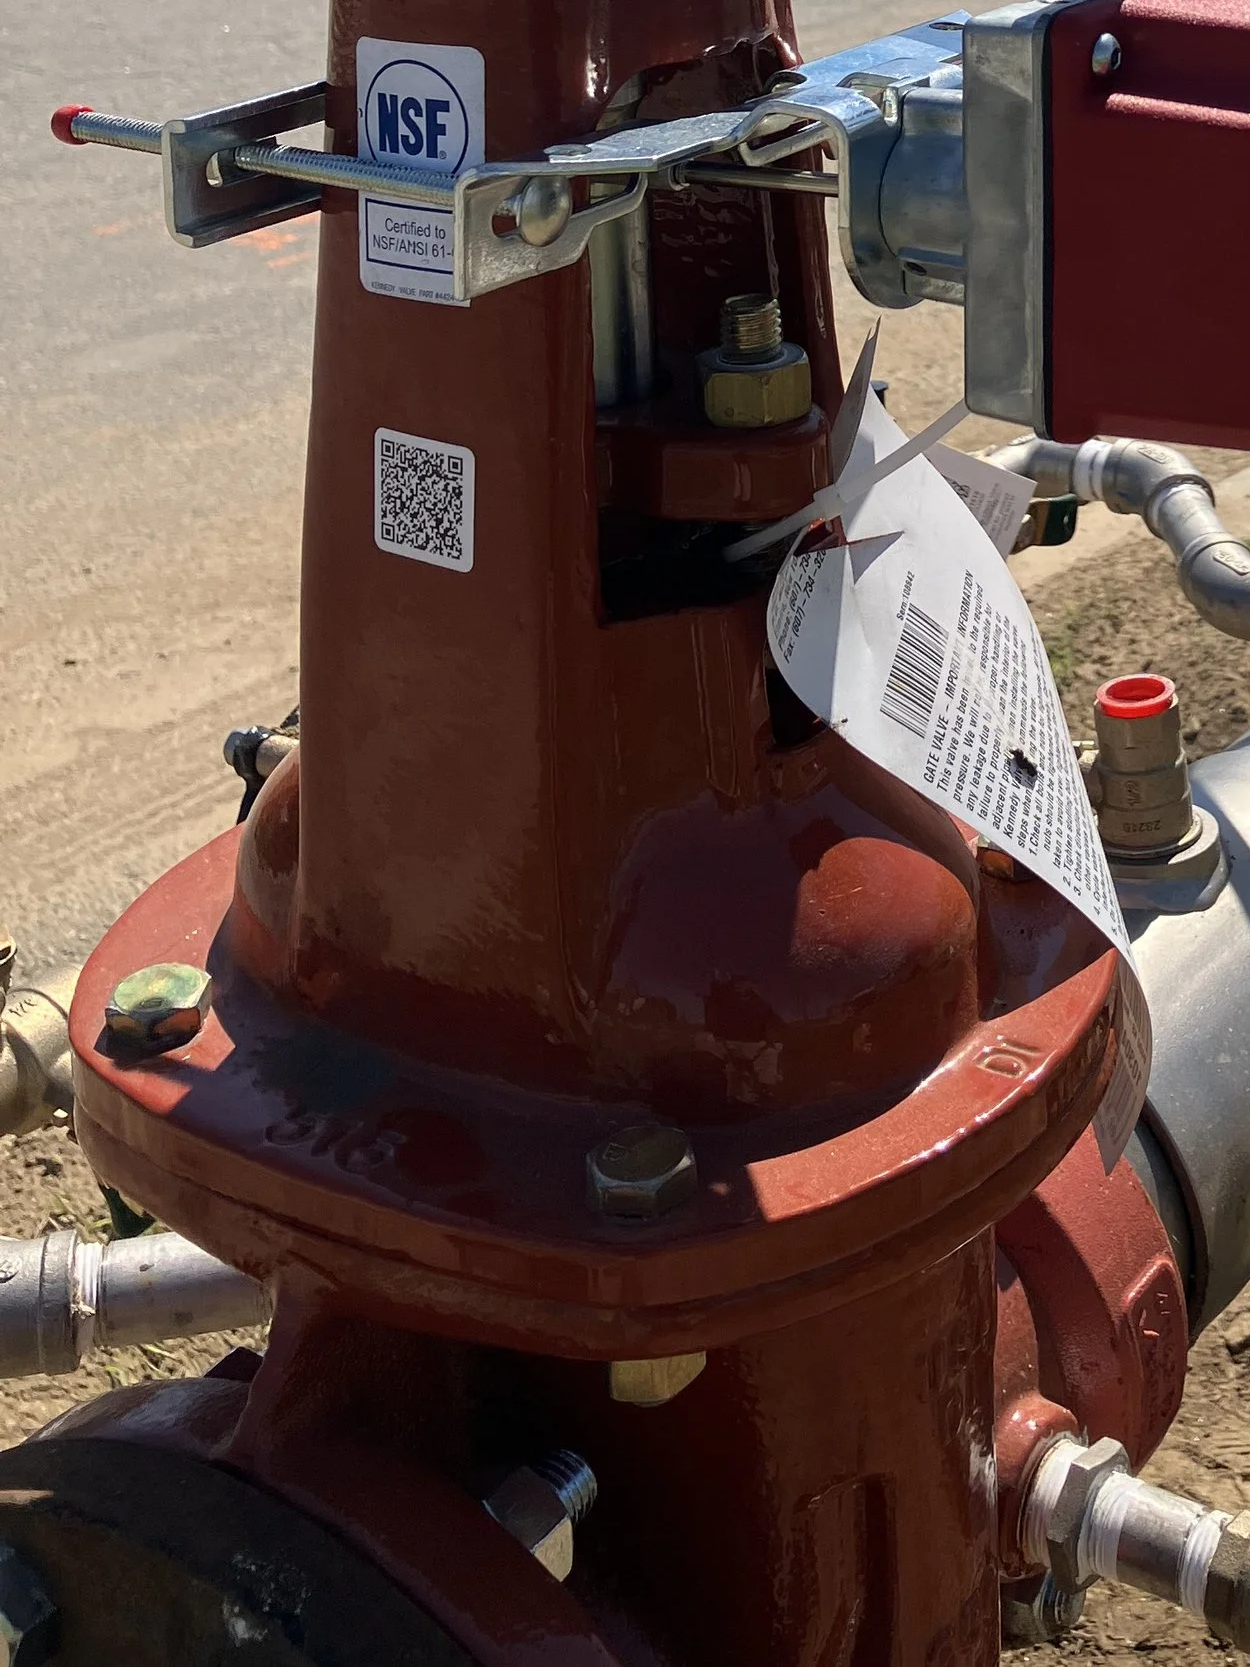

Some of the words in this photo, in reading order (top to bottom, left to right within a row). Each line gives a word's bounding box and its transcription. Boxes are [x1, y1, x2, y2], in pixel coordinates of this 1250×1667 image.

[377, 92, 450, 159] NSF
[384, 217, 431, 238] Certified
[435, 225, 446, 239] to
[432, 244, 454, 258] 61-
[956, 568, 975, 638] INFORMATION
[971, 581, 983, 624] required
[984, 601, 992, 615] for
[783, 637, 796, 664] Fax:
[792, 606, 806, 638] (607)
[803, 575, 815, 599] 734
[968, 624, 979, 642] the
[967, 642, 977, 654] to
[978, 616, 992, 673] responsible
[990, 623, 1003, 664] handling
[943, 636, 965, 699] IMPORTAT
[999, 642, 1010, 677] interior
[956, 686, 969, 714] been
[998, 677, 1008, 695] the
[950, 714, 964, 735] has
[967, 705, 979, 728] will
[982, 711, 992, 723] to
[930, 713, 949, 751] VALVE
[962, 729, 975, 747] We
[977, 724, 991, 745] due
[1027, 723, 1036, 740] the
[943, 735, 959, 766] valve
[989, 724, 1004, 771] properly
[990, 782, 1007, 830] adjacent
[1009, 666, 1019, 709] installing
[1038, 749, 1046, 771] and
[922, 750, 940, 783] GATE
[936, 766, 952, 792] This
[951, 751, 971, 803] pressure.
[968, 746, 988, 789] leakage
[984, 770, 996, 783] to
[1010, 765, 1023, 789] Valv
[1035, 770, 1044, 797] bolts
[1046, 777, 1054, 791] be
[964, 789, 979, 811] any
[976, 783, 993, 821] failure
[1019, 787, 1032, 816] when
[1034, 796, 1042, 813] all
[1046, 790, 1054, 827] should
[1056, 795, 1064, 826] avoid
[1002, 790, 1020, 839] Kennedy
[1014, 818, 1029, 848] steps
[1043, 827, 1052, 852] nuts
[1054, 826, 1062, 838] to
[1051, 839, 1062, 869] taken
[1062, 832, 1072, 871] Tighten
[1073, 850, 1081, 882] Check
[1061, 875, 1072, 887] 2.
[1072, 885, 1082, 896] 3.
